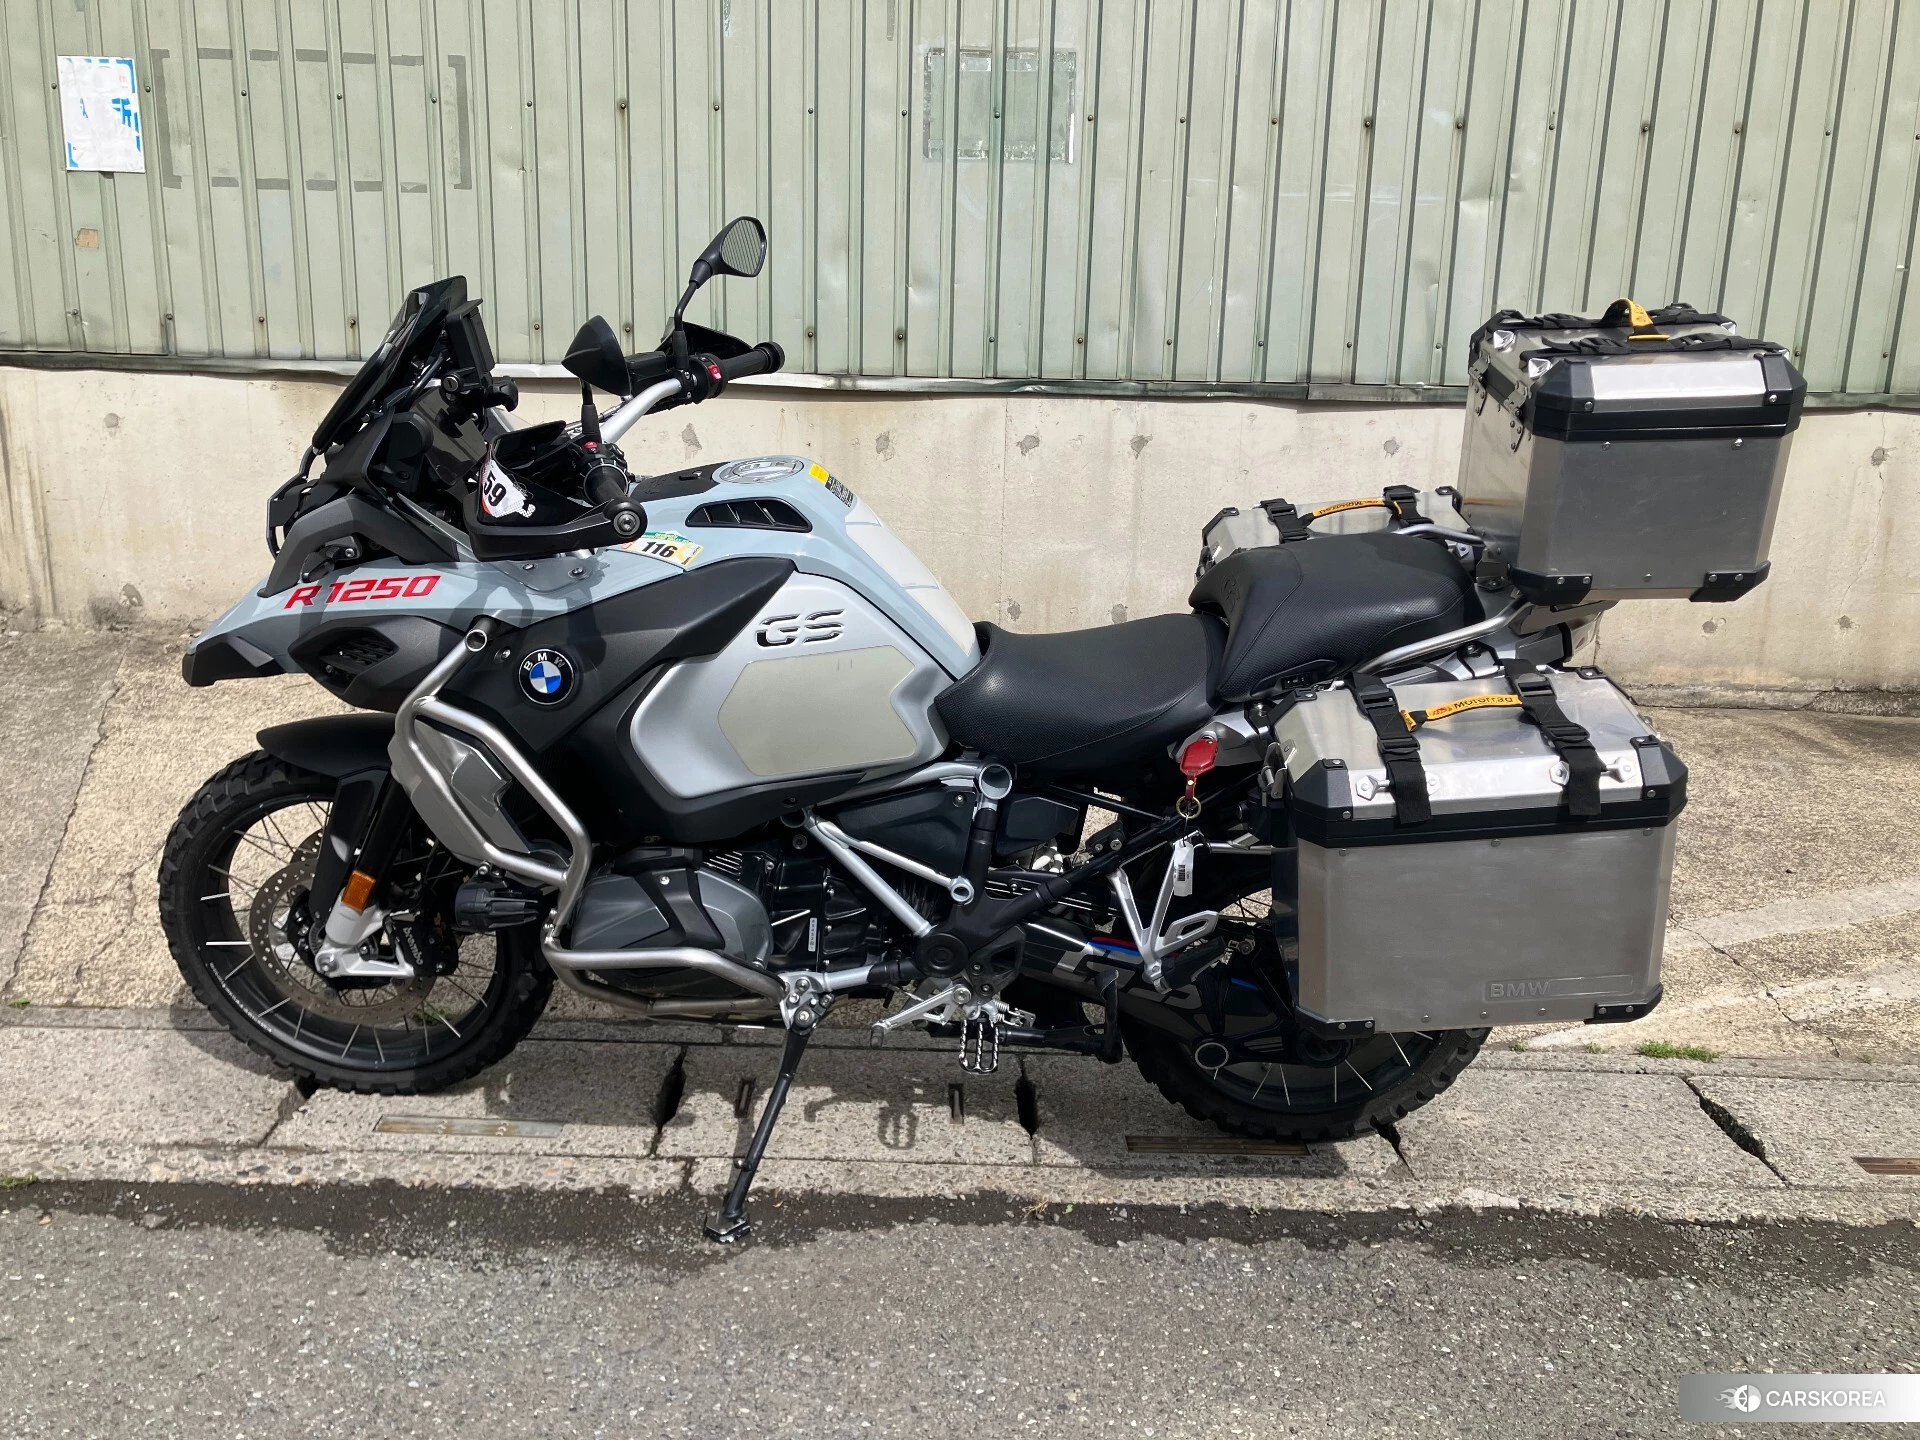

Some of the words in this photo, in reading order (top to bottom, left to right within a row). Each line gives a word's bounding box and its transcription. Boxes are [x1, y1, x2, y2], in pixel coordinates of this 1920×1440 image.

[483, 469, 507, 507] 59
[641, 541, 678, 558] 116
[284, 584, 323, 610] R
[325, 574, 442, 604] 1250
[755, 608, 845, 647] GS
[523, 652, 566, 671] BMW
[402, 926, 424, 965] brembo
[1489, 981, 1550, 998] BMW
